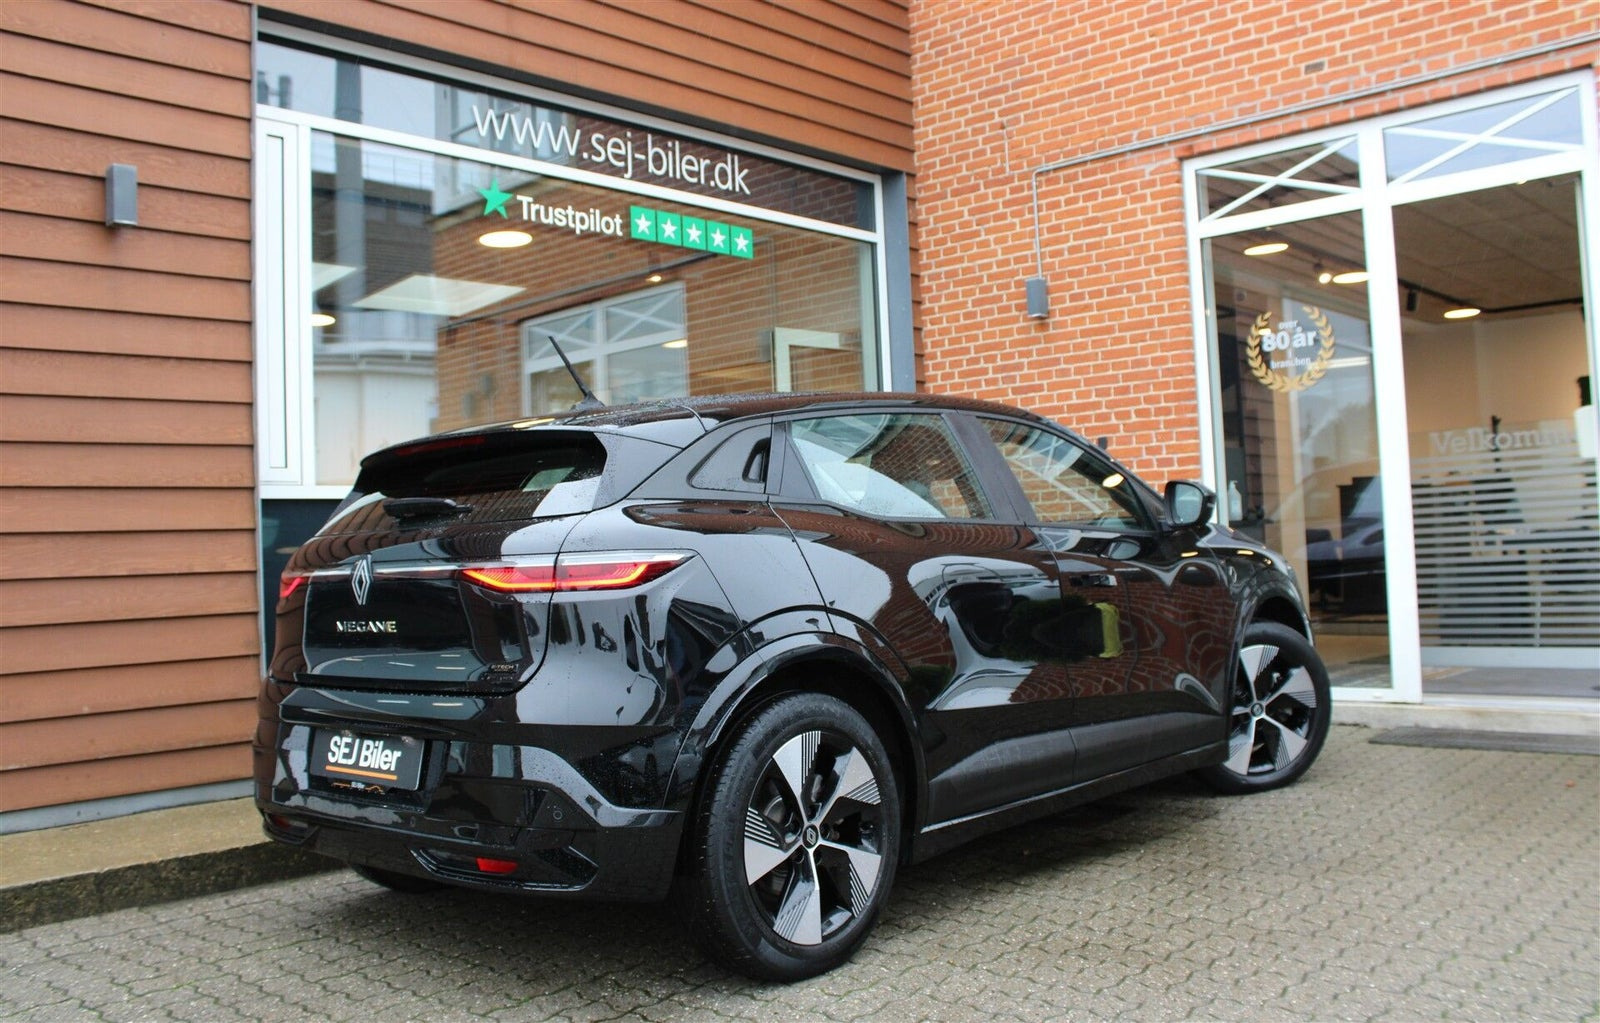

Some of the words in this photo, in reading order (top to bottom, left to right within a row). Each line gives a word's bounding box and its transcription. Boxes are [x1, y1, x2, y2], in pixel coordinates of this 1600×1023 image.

[472, 104, 751, 195] www.sej-biler.dk
[516, 194, 624, 236] Trustpilot
[1261, 331, 1290, 352] 80
[1292, 326, 1317, 348] år
[336, 620, 397, 633] MEGANE
[327, 735, 360, 766] SEJ
[359, 738, 402, 771] Biler
